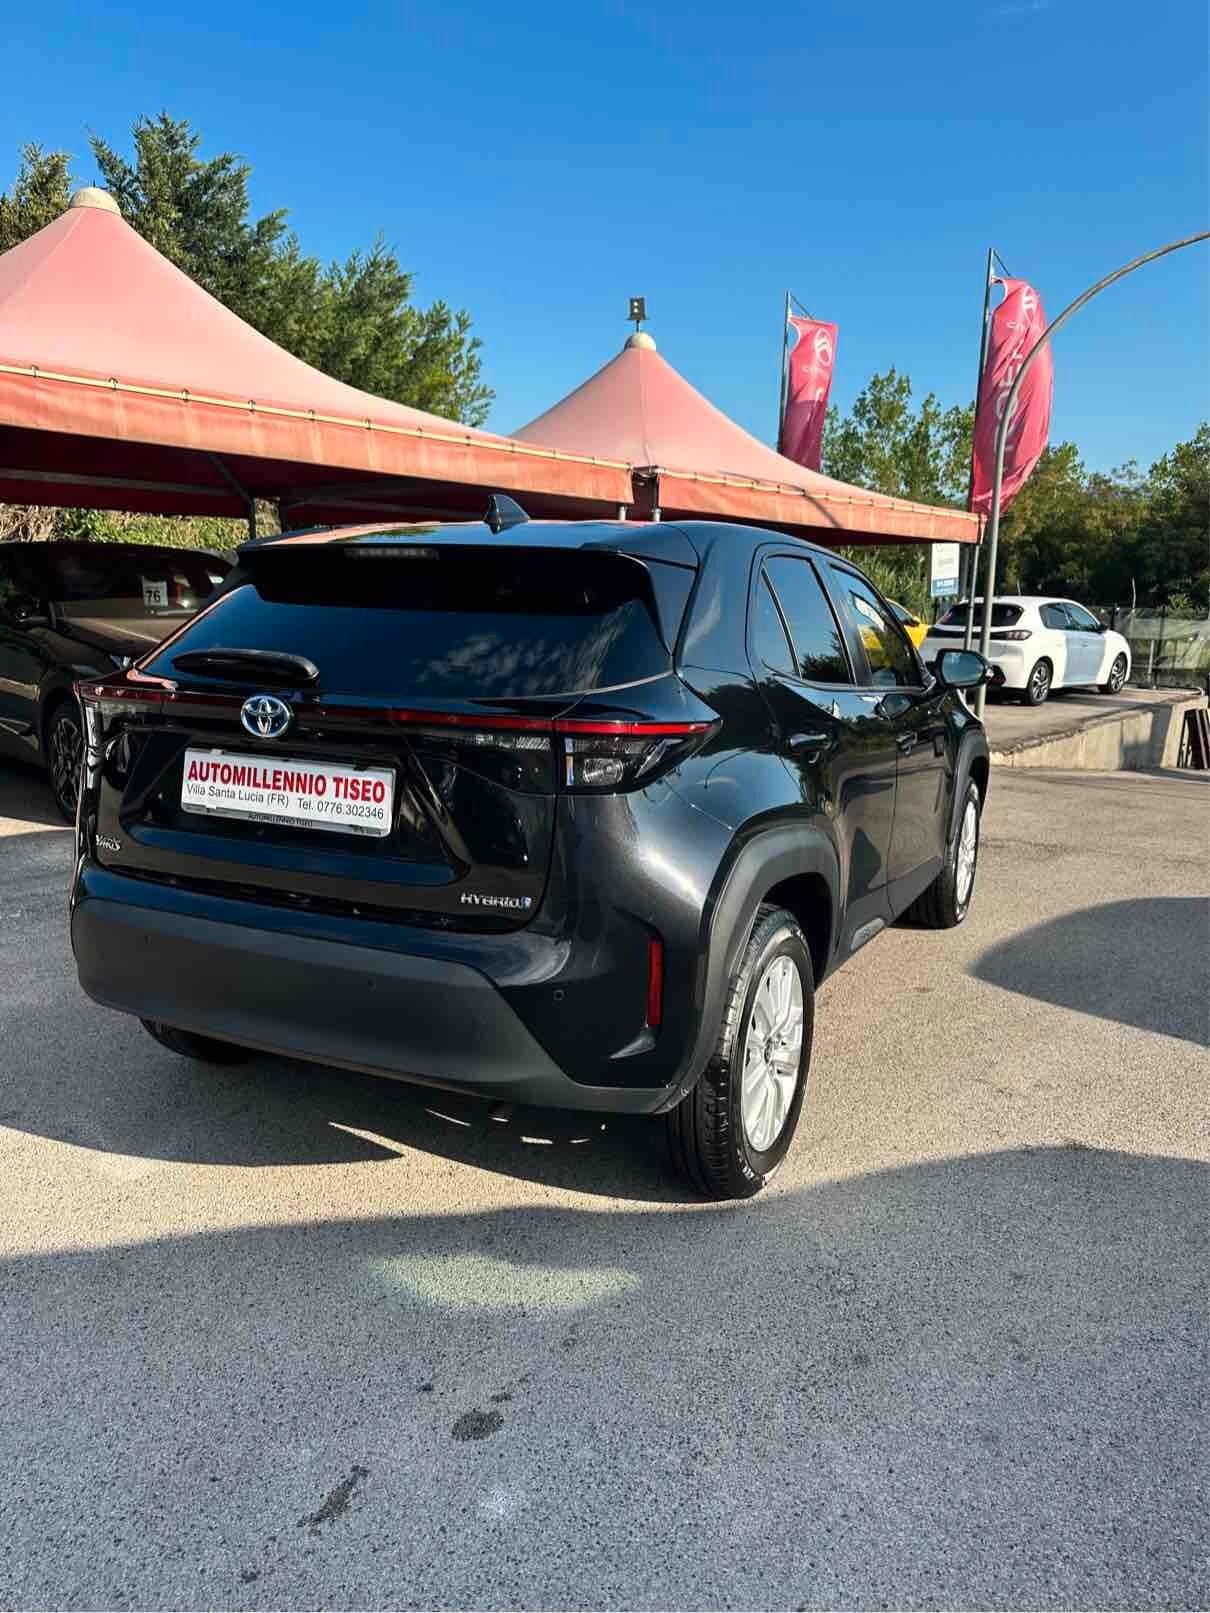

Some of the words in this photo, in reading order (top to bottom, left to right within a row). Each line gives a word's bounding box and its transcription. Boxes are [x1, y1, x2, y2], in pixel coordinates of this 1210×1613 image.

[145, 590, 160, 601] 76
[187, 760, 327, 797] AUTOMILLENNIO
[332, 776, 386, 804] TISEO
[186, 783, 206, 796] Villa
[208, 785, 236, 800] Santa
[238, 791, 264, 803] Lucia
[266, 793, 290, 809] (FR)
[297, 797, 314, 811] Tel.
[316, 801, 385, 820] 0776.302346
